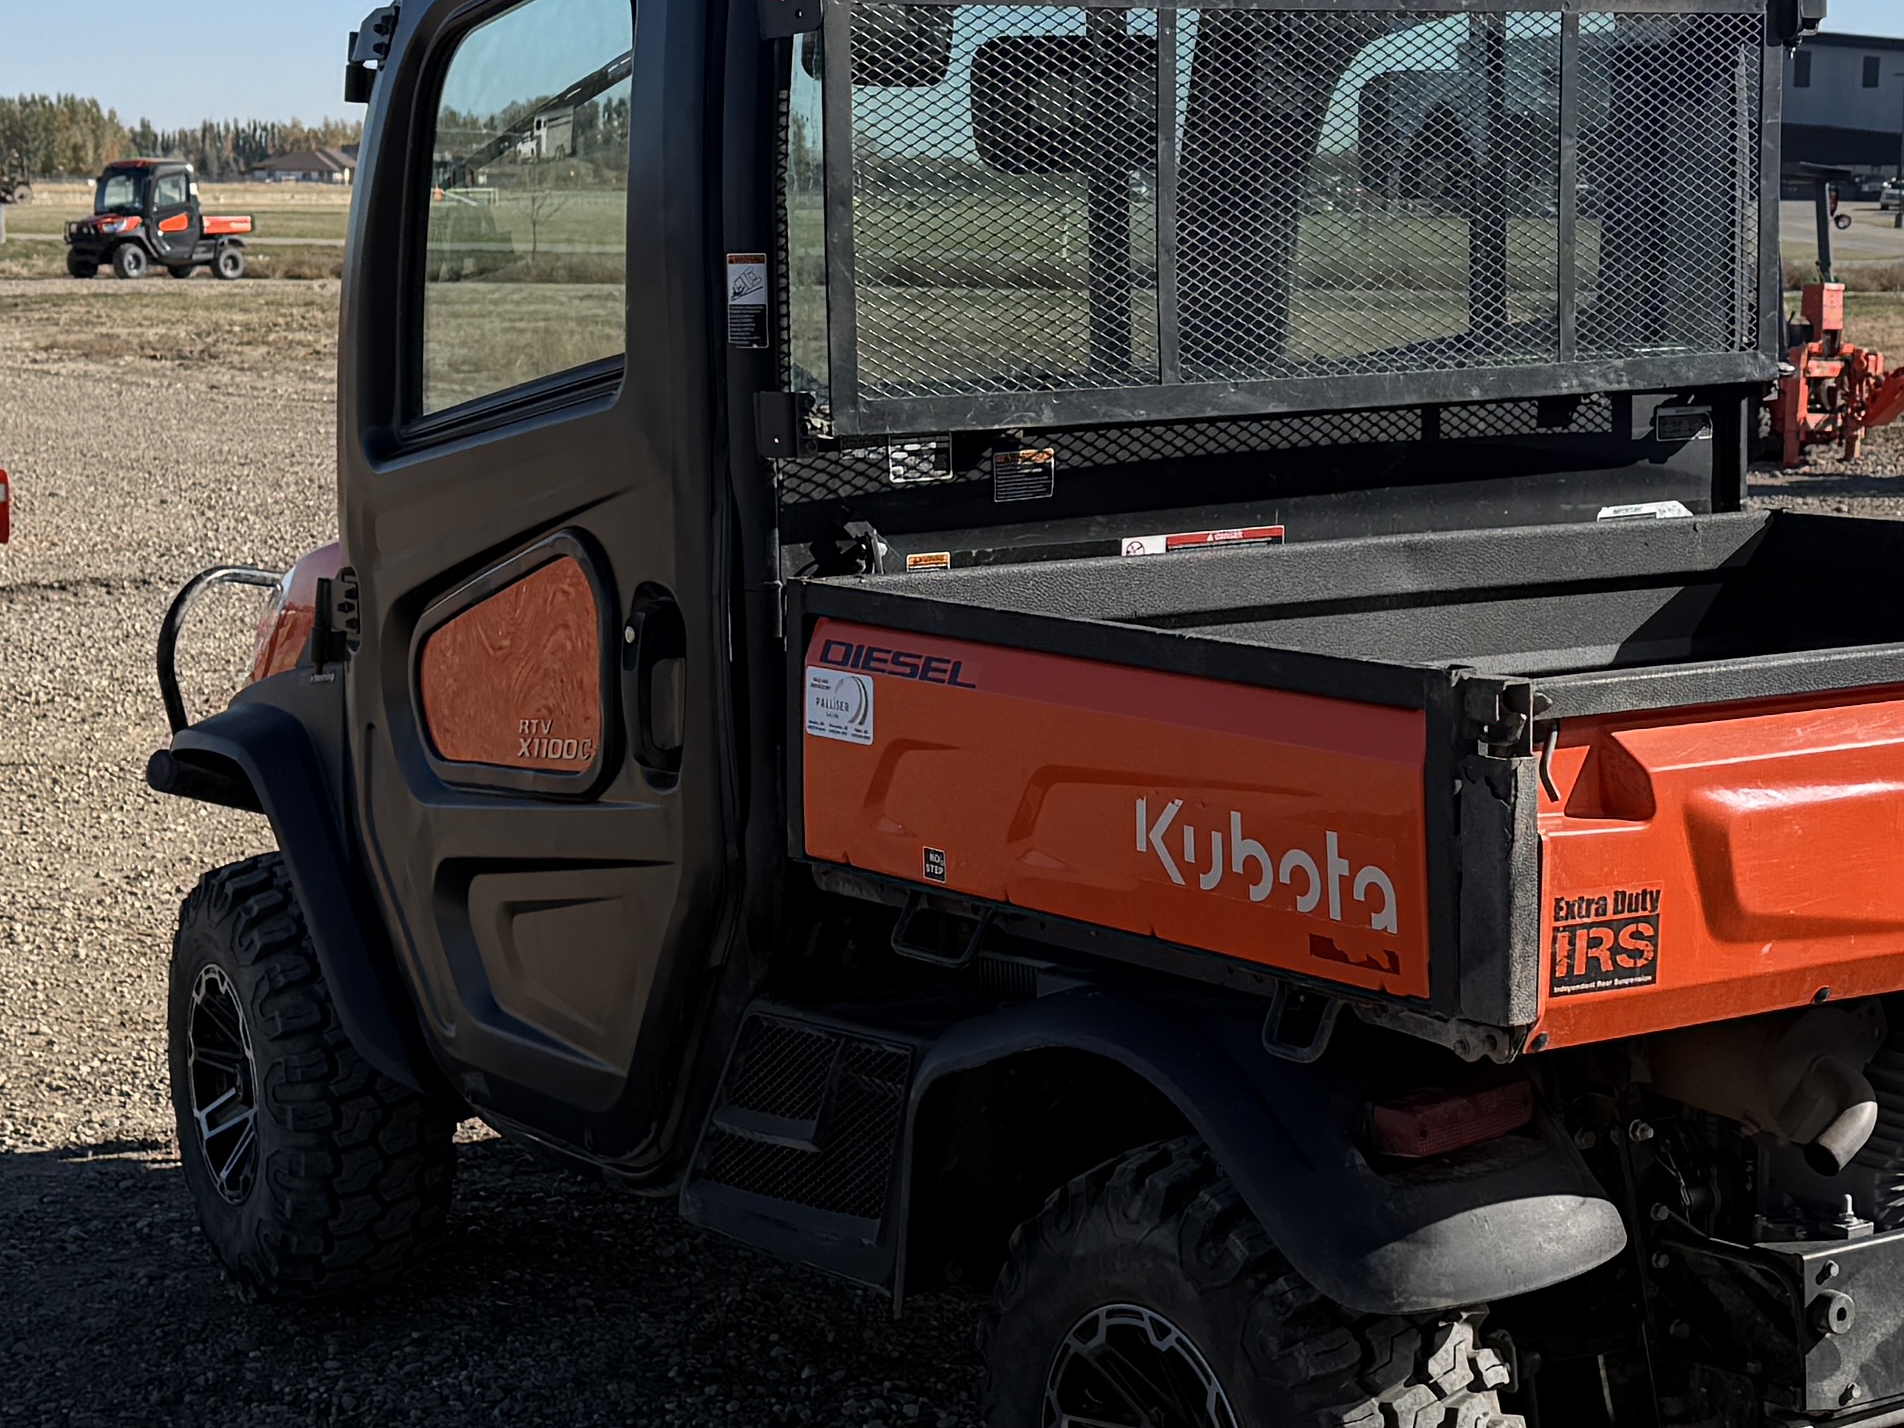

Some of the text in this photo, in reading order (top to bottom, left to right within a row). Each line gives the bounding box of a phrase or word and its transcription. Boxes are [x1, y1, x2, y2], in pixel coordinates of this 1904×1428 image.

[819, 639, 977, 690] DIESEL
[519, 719, 554, 735] RTV
[518, 738, 593, 760] X1100C
[1135, 795, 1398, 935] Kubota
[1553, 888, 1661, 923] Extra Duty
[1555, 922, 1655, 978] IRS
